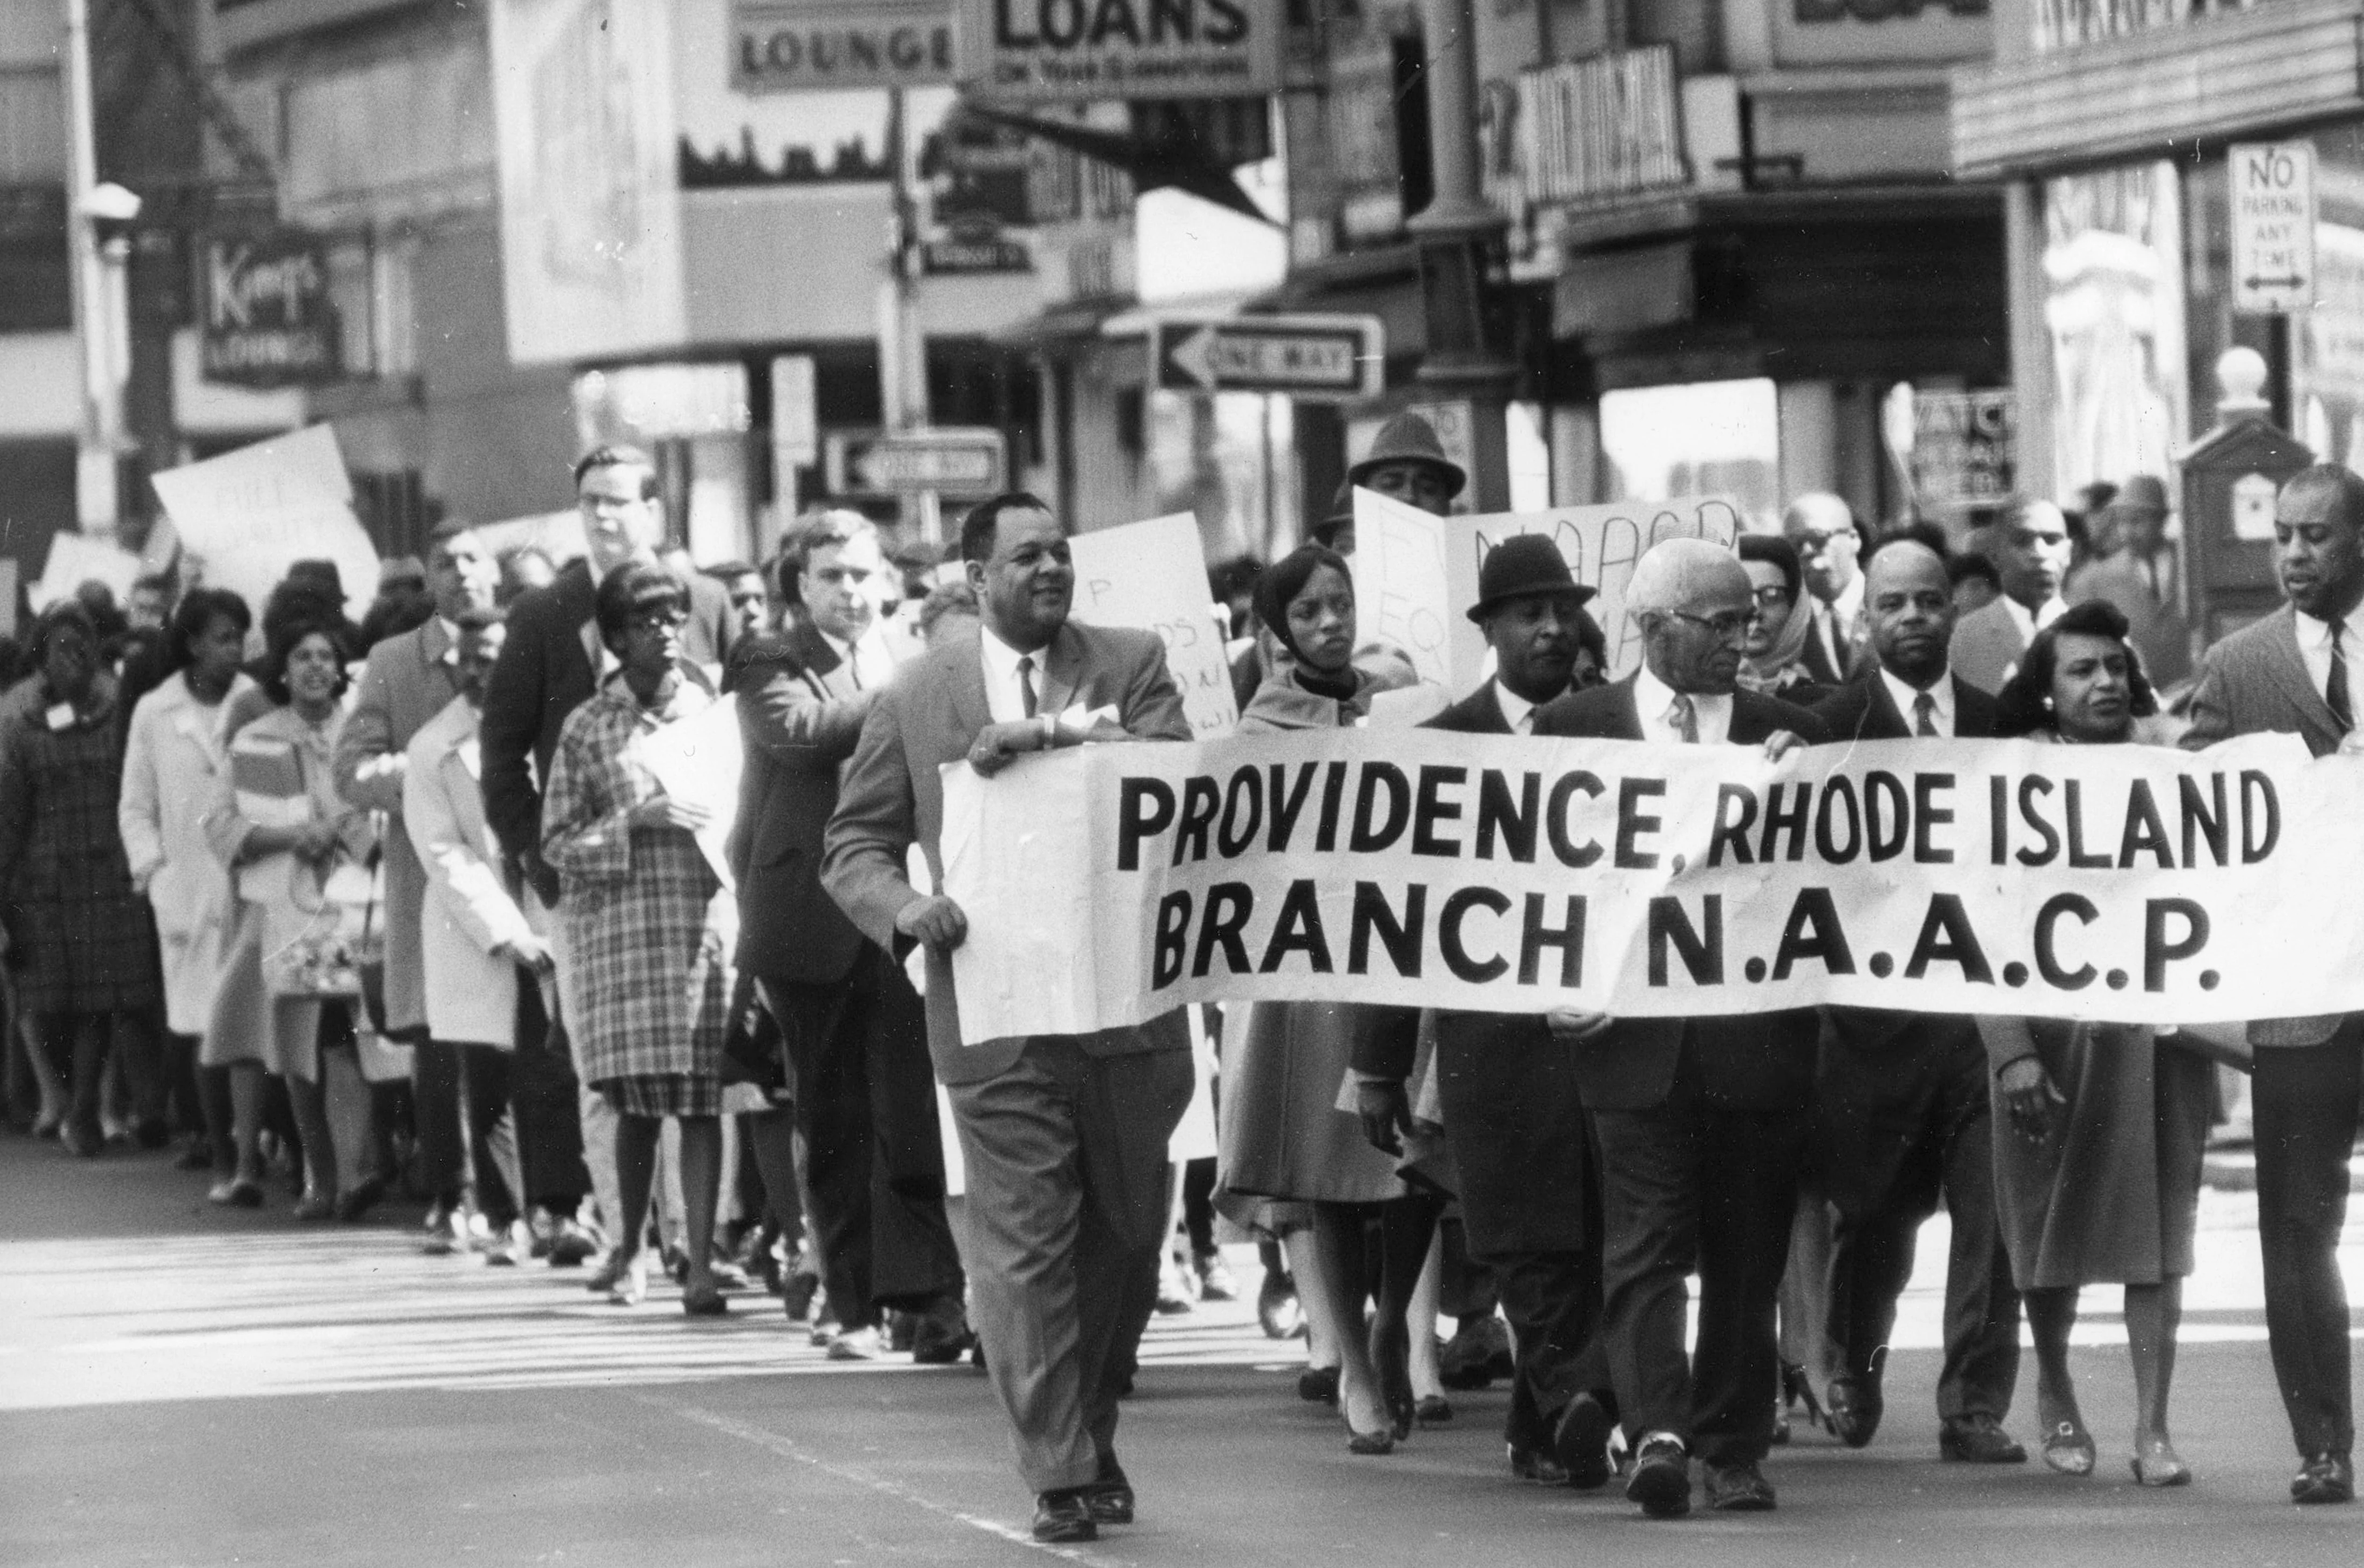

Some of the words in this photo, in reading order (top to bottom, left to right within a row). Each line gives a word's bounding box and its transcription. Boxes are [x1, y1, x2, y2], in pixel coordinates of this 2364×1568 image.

[2250, 156, 2293, 188] NO
[1117, 761, 1686, 875] PROVIDENCE,
[1706, 771, 1956, 869] RHODE
[1990, 769, 2282, 870] ISLAND
[1151, 879, 1588, 991] BRANCH
[1647, 887, 2221, 993] N.A.A.C.P.
